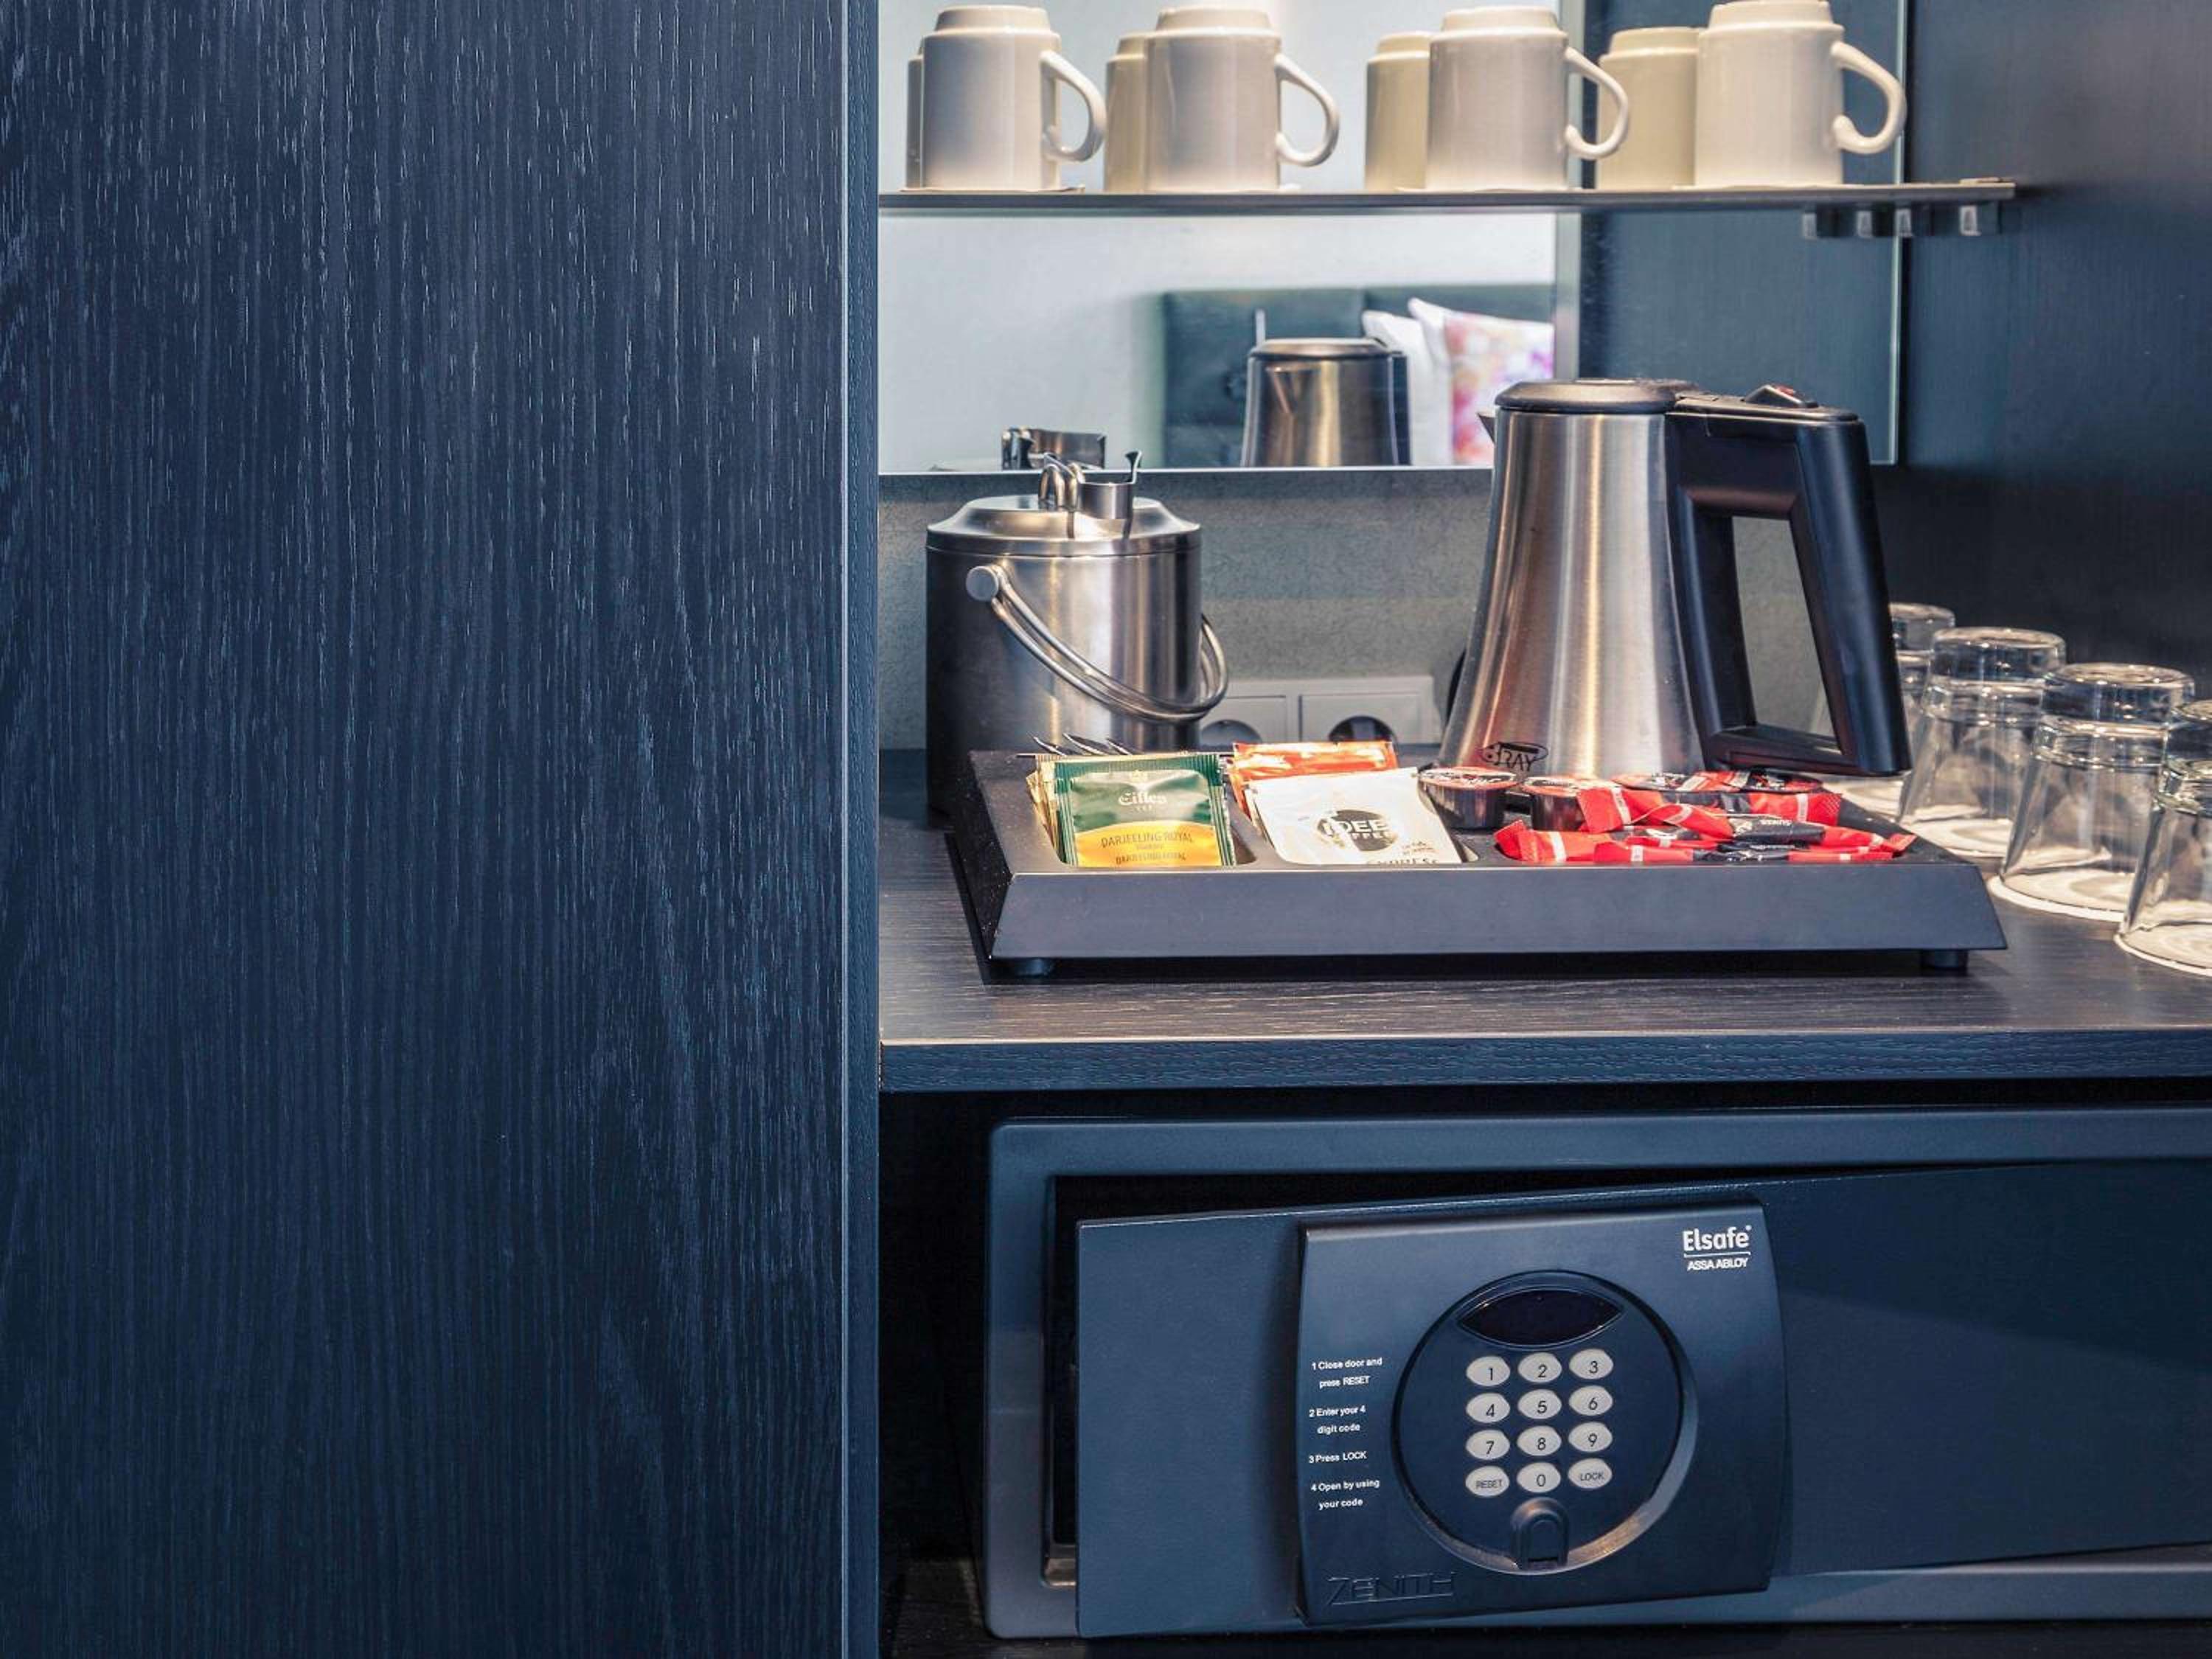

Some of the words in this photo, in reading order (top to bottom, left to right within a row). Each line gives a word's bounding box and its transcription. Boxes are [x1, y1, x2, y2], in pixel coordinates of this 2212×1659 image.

[1687, 1259, 1714, 1271] ASSA
[1716, 1257, 1749, 1269] ABLOY
[1312, 1362, 1317, 1370] 1
[1318, 1360, 1343, 1370] Close
[1345, 1359, 1365, 1368] door
[1366, 1357, 1382, 1366] and
[1537, 1363, 1548, 1378] 2
[1588, 1360, 1599, 1374] 3
[1319, 1379, 1341, 1389] press
[1343, 1375, 1371, 1385] RESET
[1485, 1403, 1495, 1417] 4
[1537, 1400, 1548, 1414] 5
[1588, 1397, 1599, 1411] 6
[1310, 1409, 1315, 1418] 2
[1316, 1408, 1338, 1416] Enter
[1339, 1407, 1359, 1416] your
[1360, 1405, 1366, 1413] 4
[1317, 1425, 1338, 1436] digit
[1338, 1423, 1361, 1433] code
[1537, 1437, 1547, 1451] 8
[1587, 1433, 1598, 1447] 9
[1486, 1440, 1495, 1455] 7
[1309, 1455, 1315, 1464] 3
[1315, 1454, 1340, 1463] Press
[1343, 1450, 1368, 1461] LOCK
[1536, 1473, 1547, 1487] 0
[1580, 1470, 1604, 1482] LOCK
[1310, 1484, 1317, 1492] 4
[1318, 1483, 1342, 1492] Open
[1343, 1481, 1354, 1491] by
[1355, 1478, 1380, 1488] using
[1475, 1478, 1503, 1490] RESET
[1318, 1500, 1340, 1511] your
[1340, 1498, 1363, 1507] code
[1326, 1571, 1455, 1606] ZENITH
